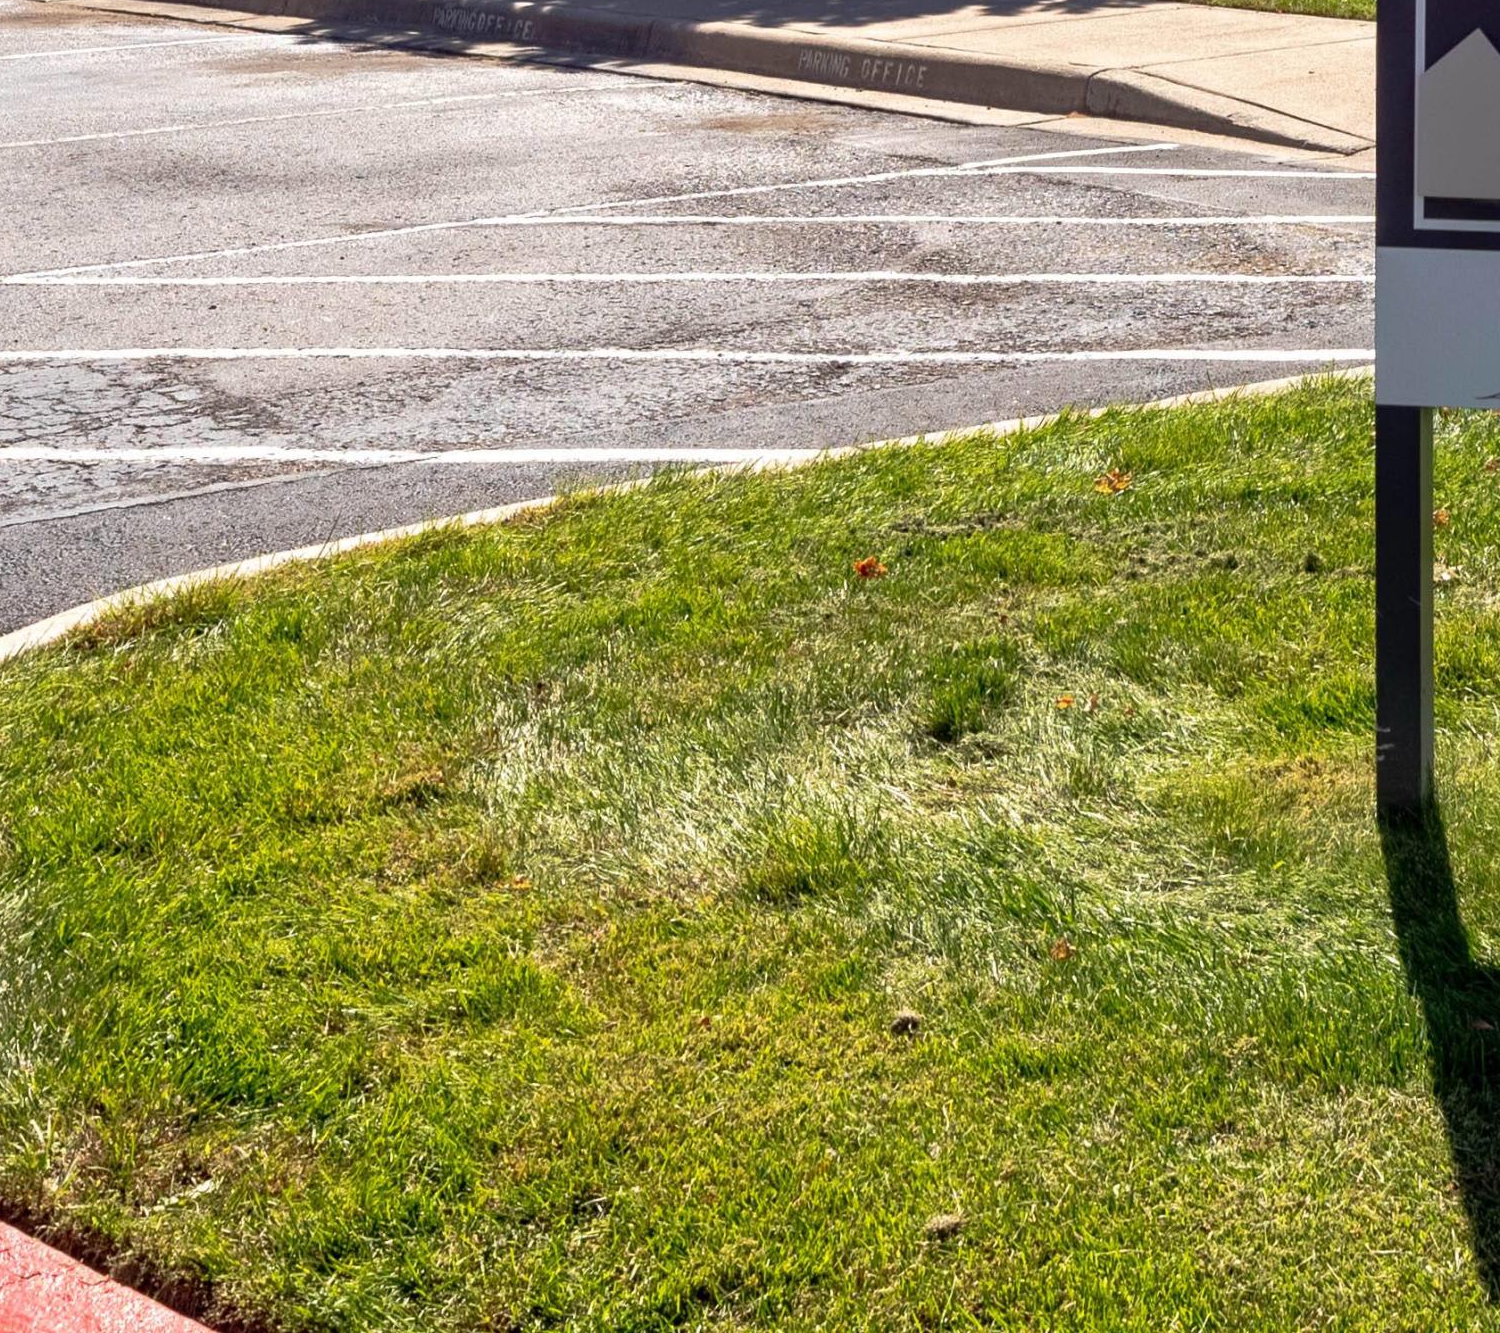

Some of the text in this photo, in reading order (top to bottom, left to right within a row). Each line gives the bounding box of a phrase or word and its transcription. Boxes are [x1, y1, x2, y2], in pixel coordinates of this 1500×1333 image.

[432, 7, 534, 41] PARKING OFFICE
[798, 49, 928, 88] PARKING OFFICE
